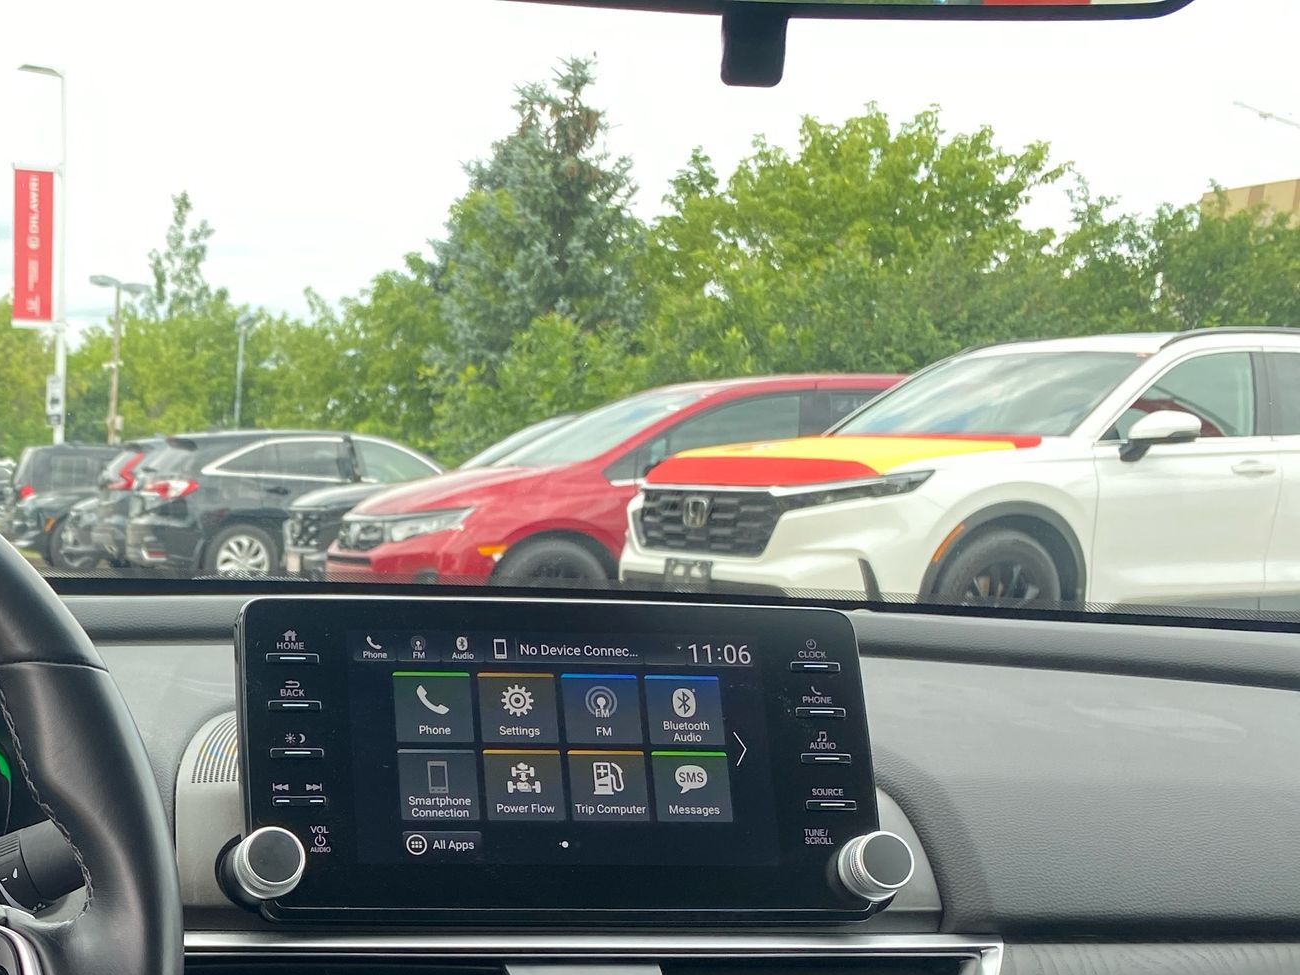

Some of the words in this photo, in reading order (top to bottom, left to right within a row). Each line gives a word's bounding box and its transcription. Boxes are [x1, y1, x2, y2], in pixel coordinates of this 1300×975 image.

[276, 641, 305, 650] HOME
[519, 644, 538, 656] No
[540, 644, 581, 656] Device
[362, 650, 388, 659] Phone
[412, 651, 426, 659] FM
[451, 651, 475, 660] Audio
[687, 643, 752, 664] 11:06
[798, 650, 827, 659] CLOCK
[280, 688, 305, 697] BACK
[802, 696, 832, 705] PHONE
[418, 725, 452, 737] Phone
[499, 725, 541, 738] Settings
[596, 726, 613, 737] FM
[663, 720, 710, 732] Bluetooth
[673, 732, 702, 743] Audio
[809, 741, 837, 750] AUDIO
[678, 771, 705, 784] SMS
[811, 788, 844, 797] SOURCE
[408, 796, 472, 809] Smartphone
[411, 807, 470, 818] Connection
[496, 803, 528, 813] Power
[531, 803, 555, 814] Flow
[575, 804, 596, 816] Trip
[597, 804, 646, 816] Computer
[668, 804, 721, 817] Messages
[310, 825, 330, 835] VOL
[804, 828, 829, 837] TUNE/
[432, 839, 447, 850] All
[448, 840, 475, 851] Apps
[804, 837, 834, 845] SCROLL
